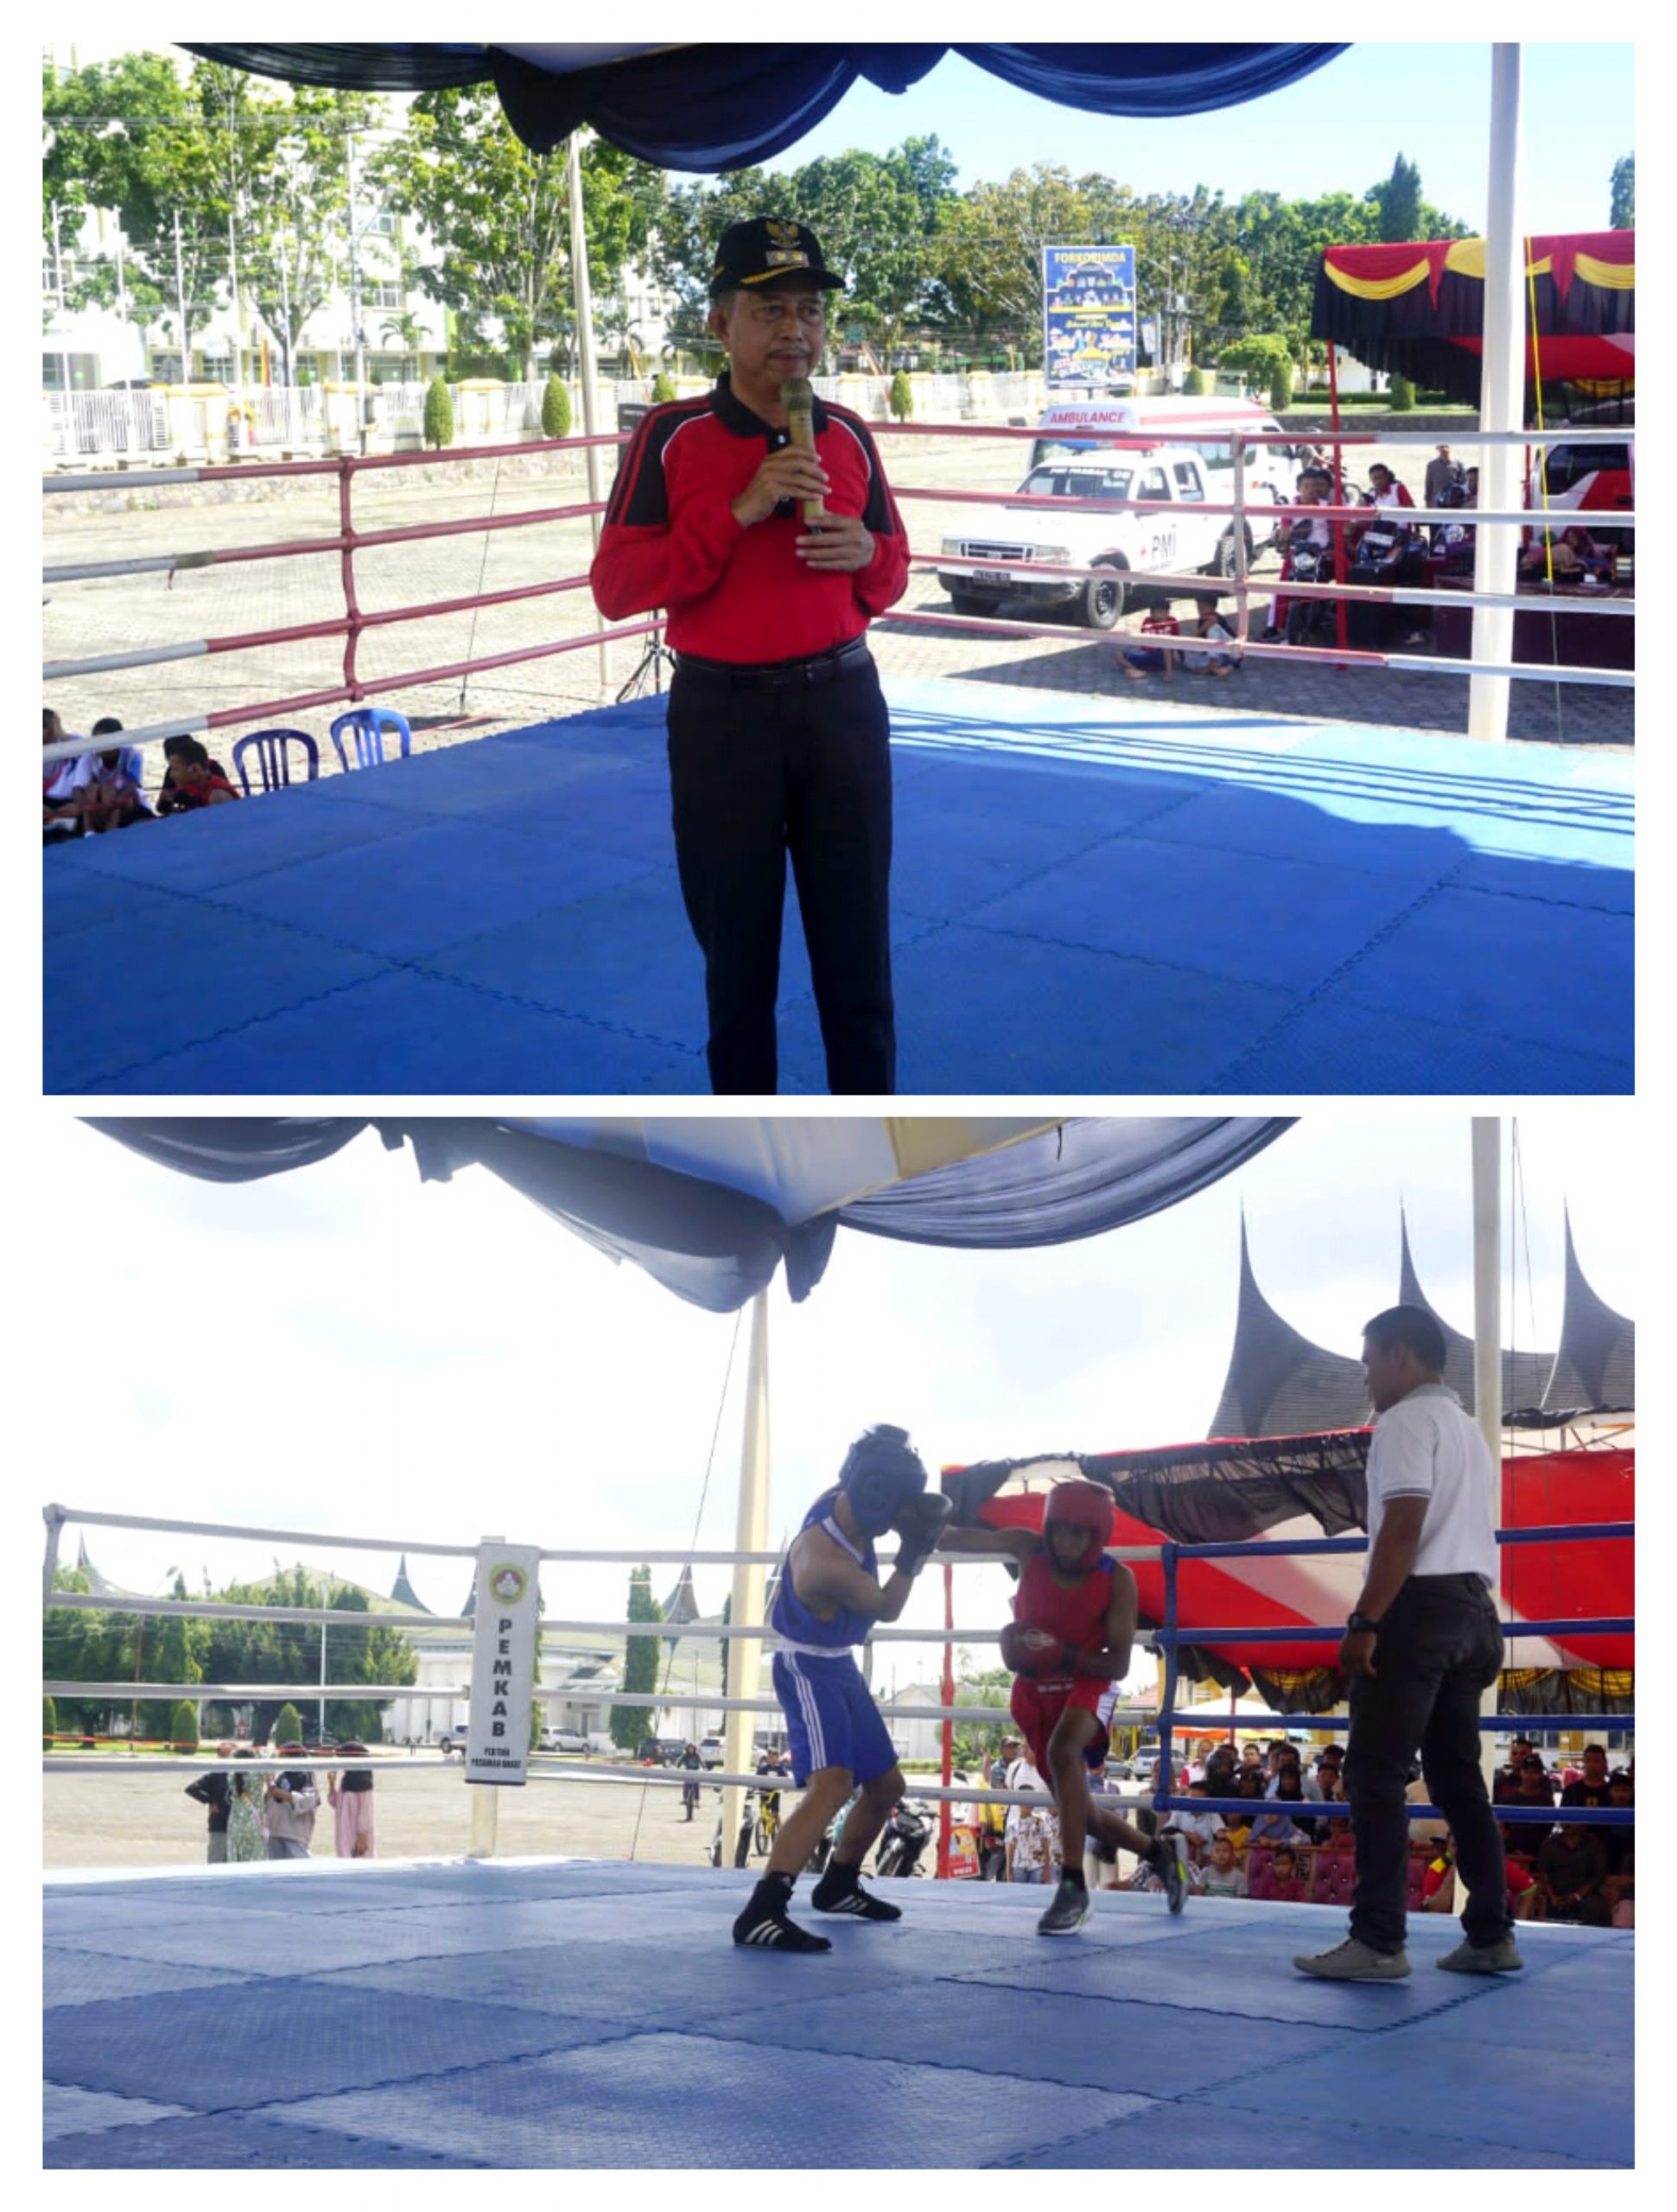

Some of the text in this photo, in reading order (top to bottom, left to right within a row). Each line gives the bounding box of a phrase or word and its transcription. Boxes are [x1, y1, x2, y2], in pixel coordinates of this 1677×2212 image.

[1050, 410, 1126, 423] AMBULANCE
[1151, 531, 1177, 561] PMI
[492, 1618, 512, 1737] PEMKAB
